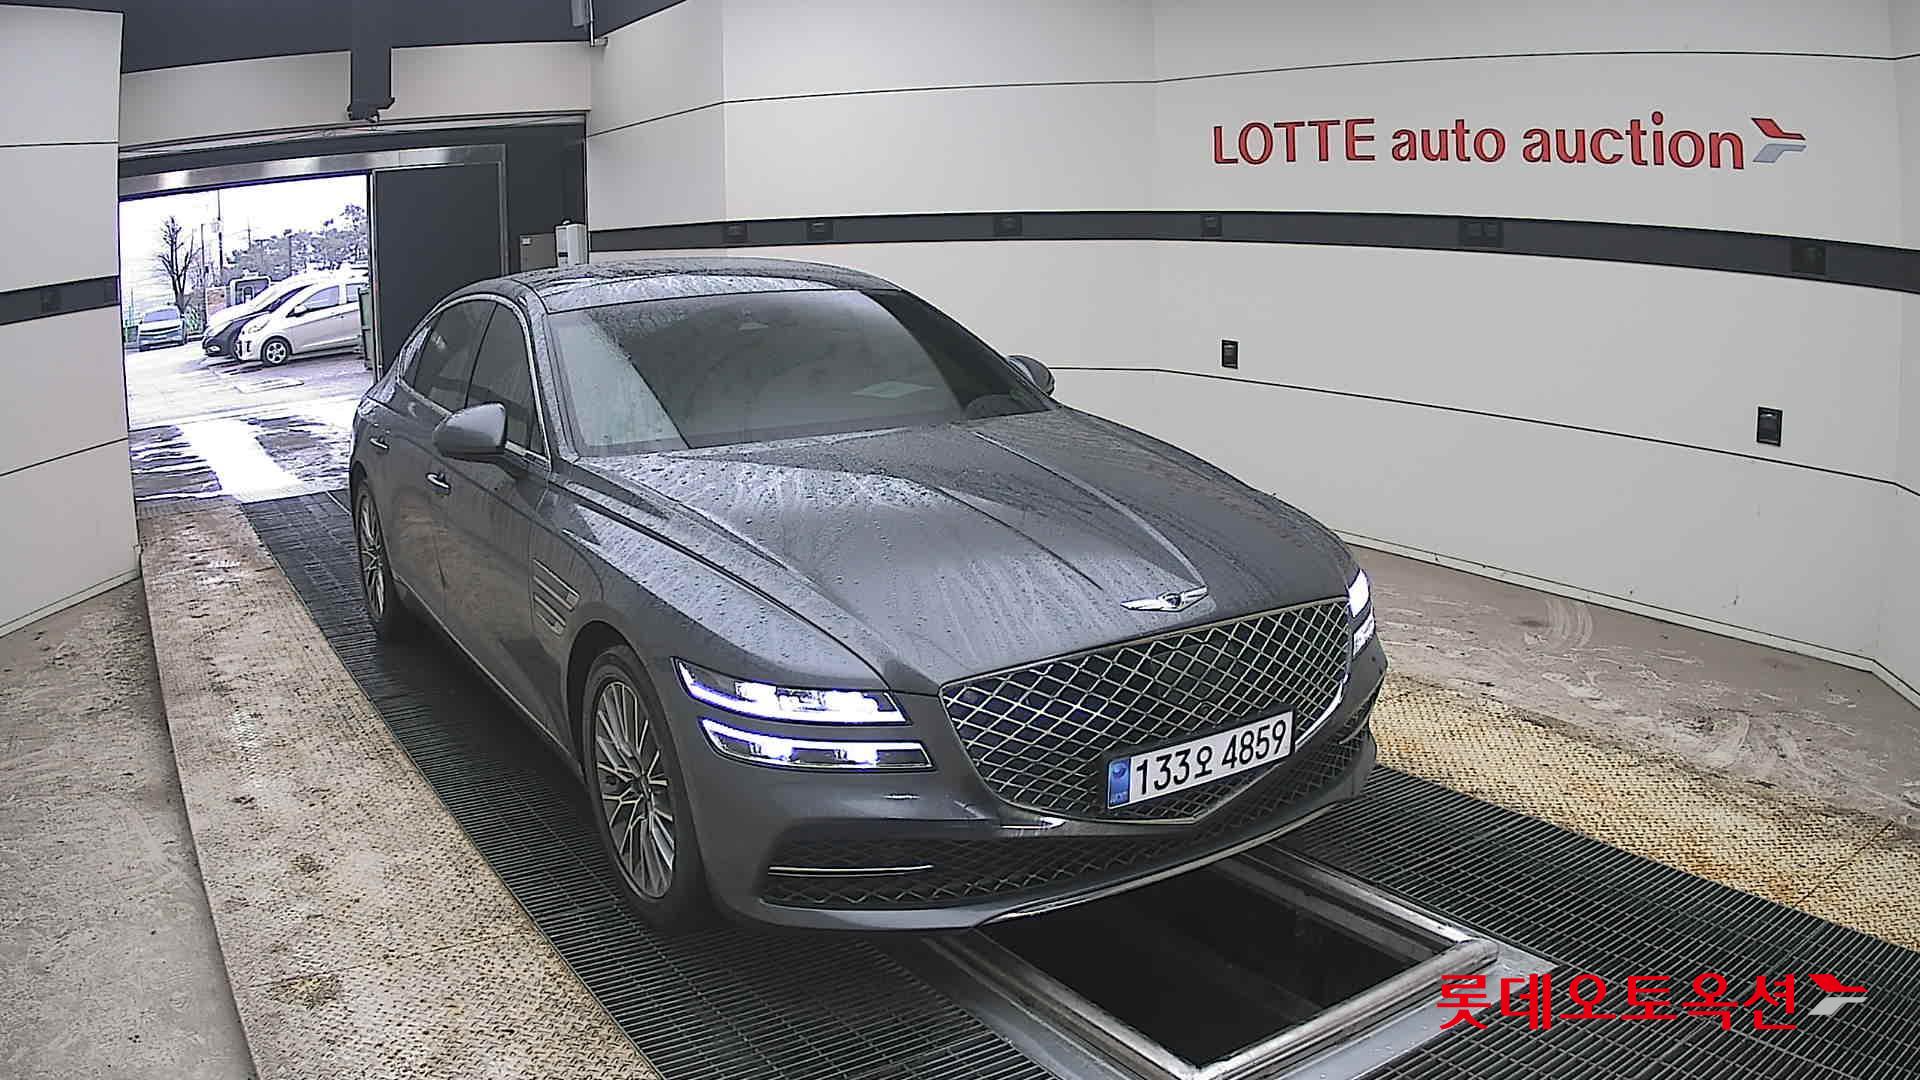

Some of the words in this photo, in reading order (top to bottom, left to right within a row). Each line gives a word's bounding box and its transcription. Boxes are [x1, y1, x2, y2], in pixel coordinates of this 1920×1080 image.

[1212, 118, 1376, 165] LOTTE
[1391, 119, 1506, 162] auto
[1522, 111, 1744, 170] auction
[1136, 746, 1213, 795] 133오
[1221, 719, 1287, 769] 4859
